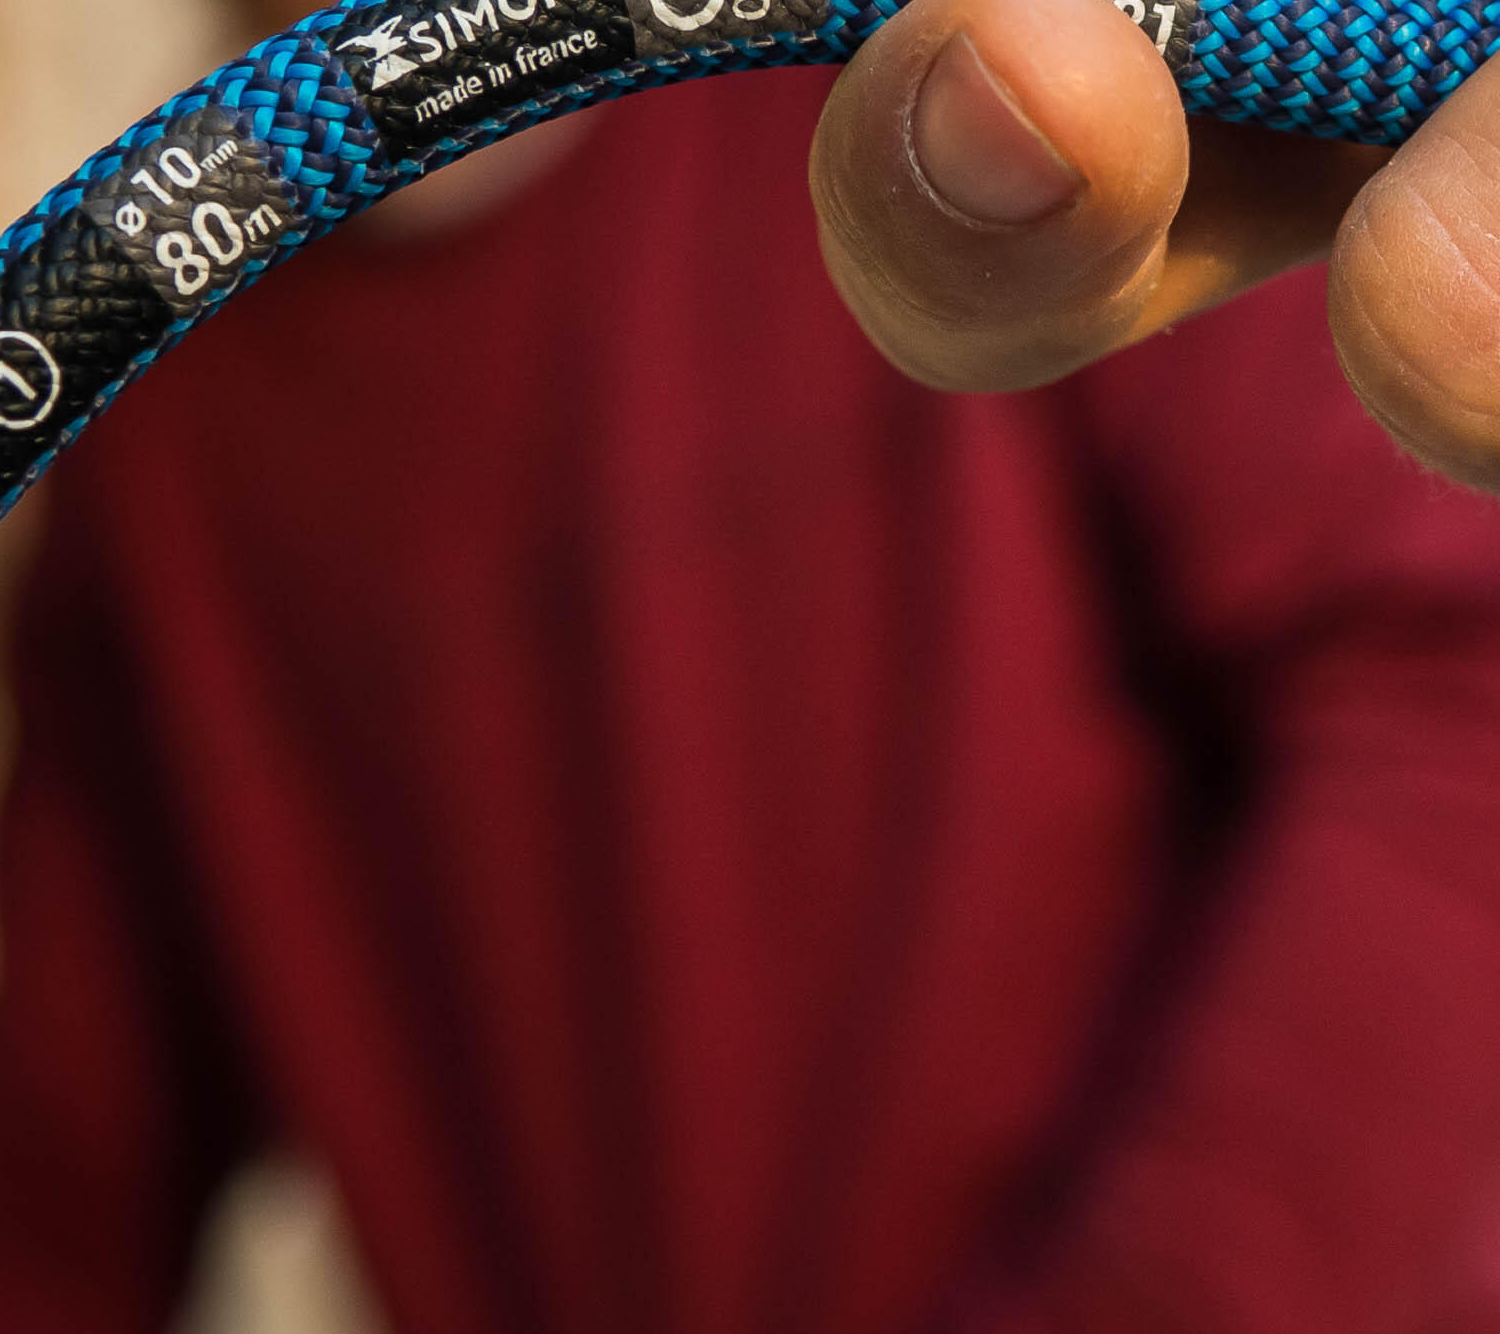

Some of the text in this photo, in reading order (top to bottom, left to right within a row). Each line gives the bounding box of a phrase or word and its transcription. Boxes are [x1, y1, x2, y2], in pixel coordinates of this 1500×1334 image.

[415, 29, 598, 123] made in france
